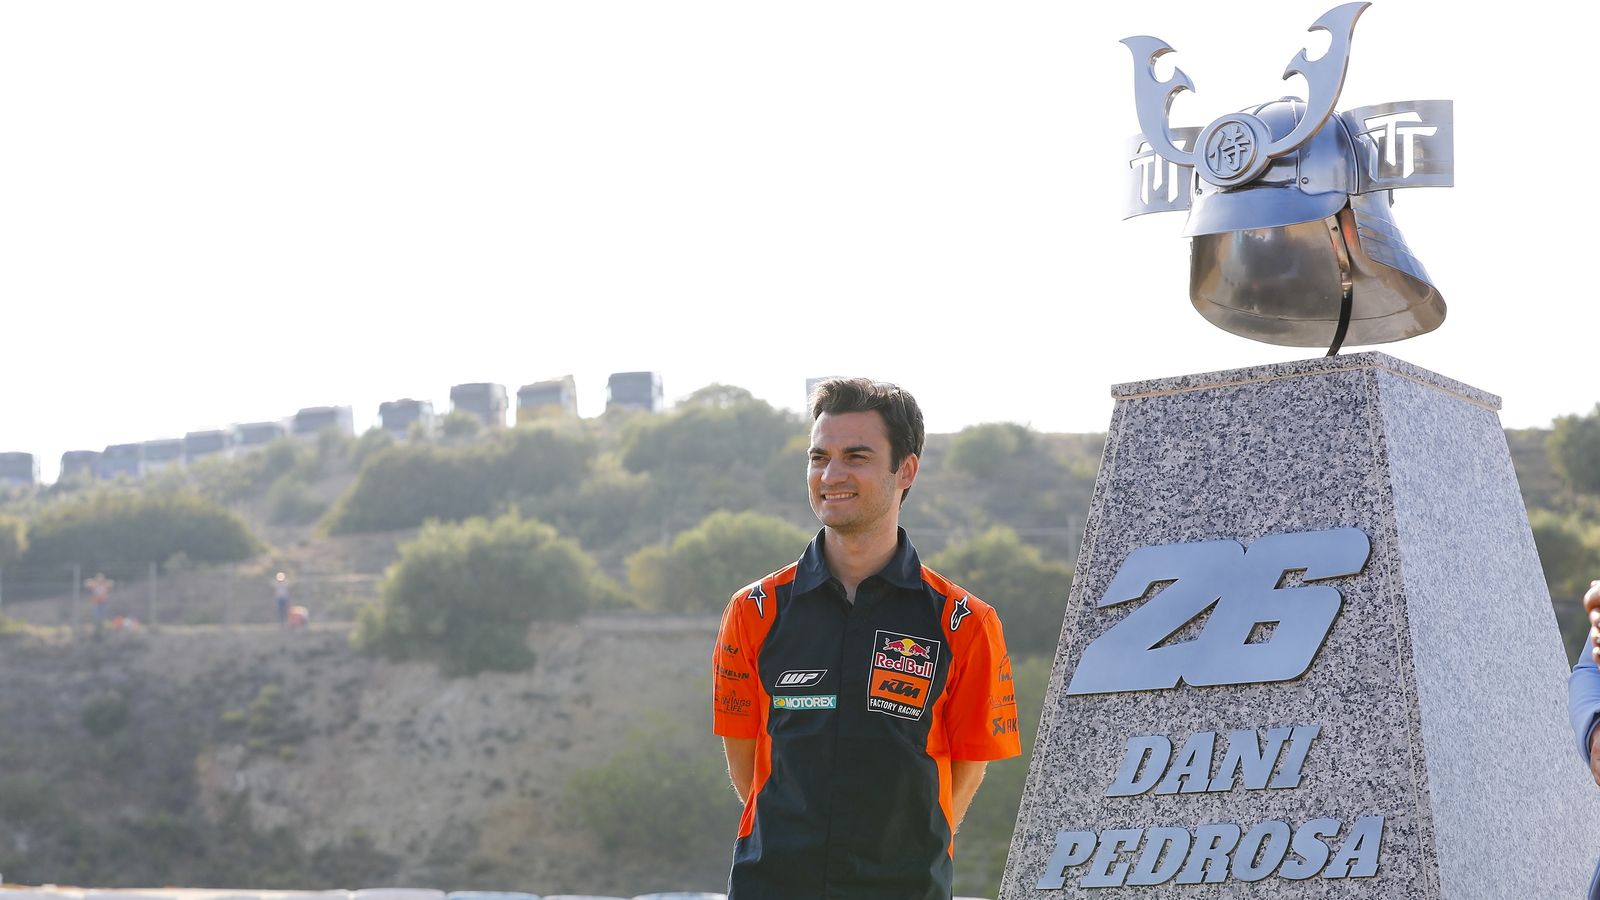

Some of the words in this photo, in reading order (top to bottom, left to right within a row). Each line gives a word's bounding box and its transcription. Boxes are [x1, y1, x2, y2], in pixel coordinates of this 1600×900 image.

[1208, 124, 1251, 172] 侍
[1067, 527, 1371, 695] 26
[874, 652, 905, 671] Red
[905, 658, 934, 678] Bull
[785, 697, 834, 708] MOTOREX
[870, 698, 897, 711] FACTORY
[898, 704, 921, 716] RACING
[879, 679, 920, 698] KTM
[1107, 724, 1321, 797] DANI
[1036, 815, 1385, 890] PEDROSA
